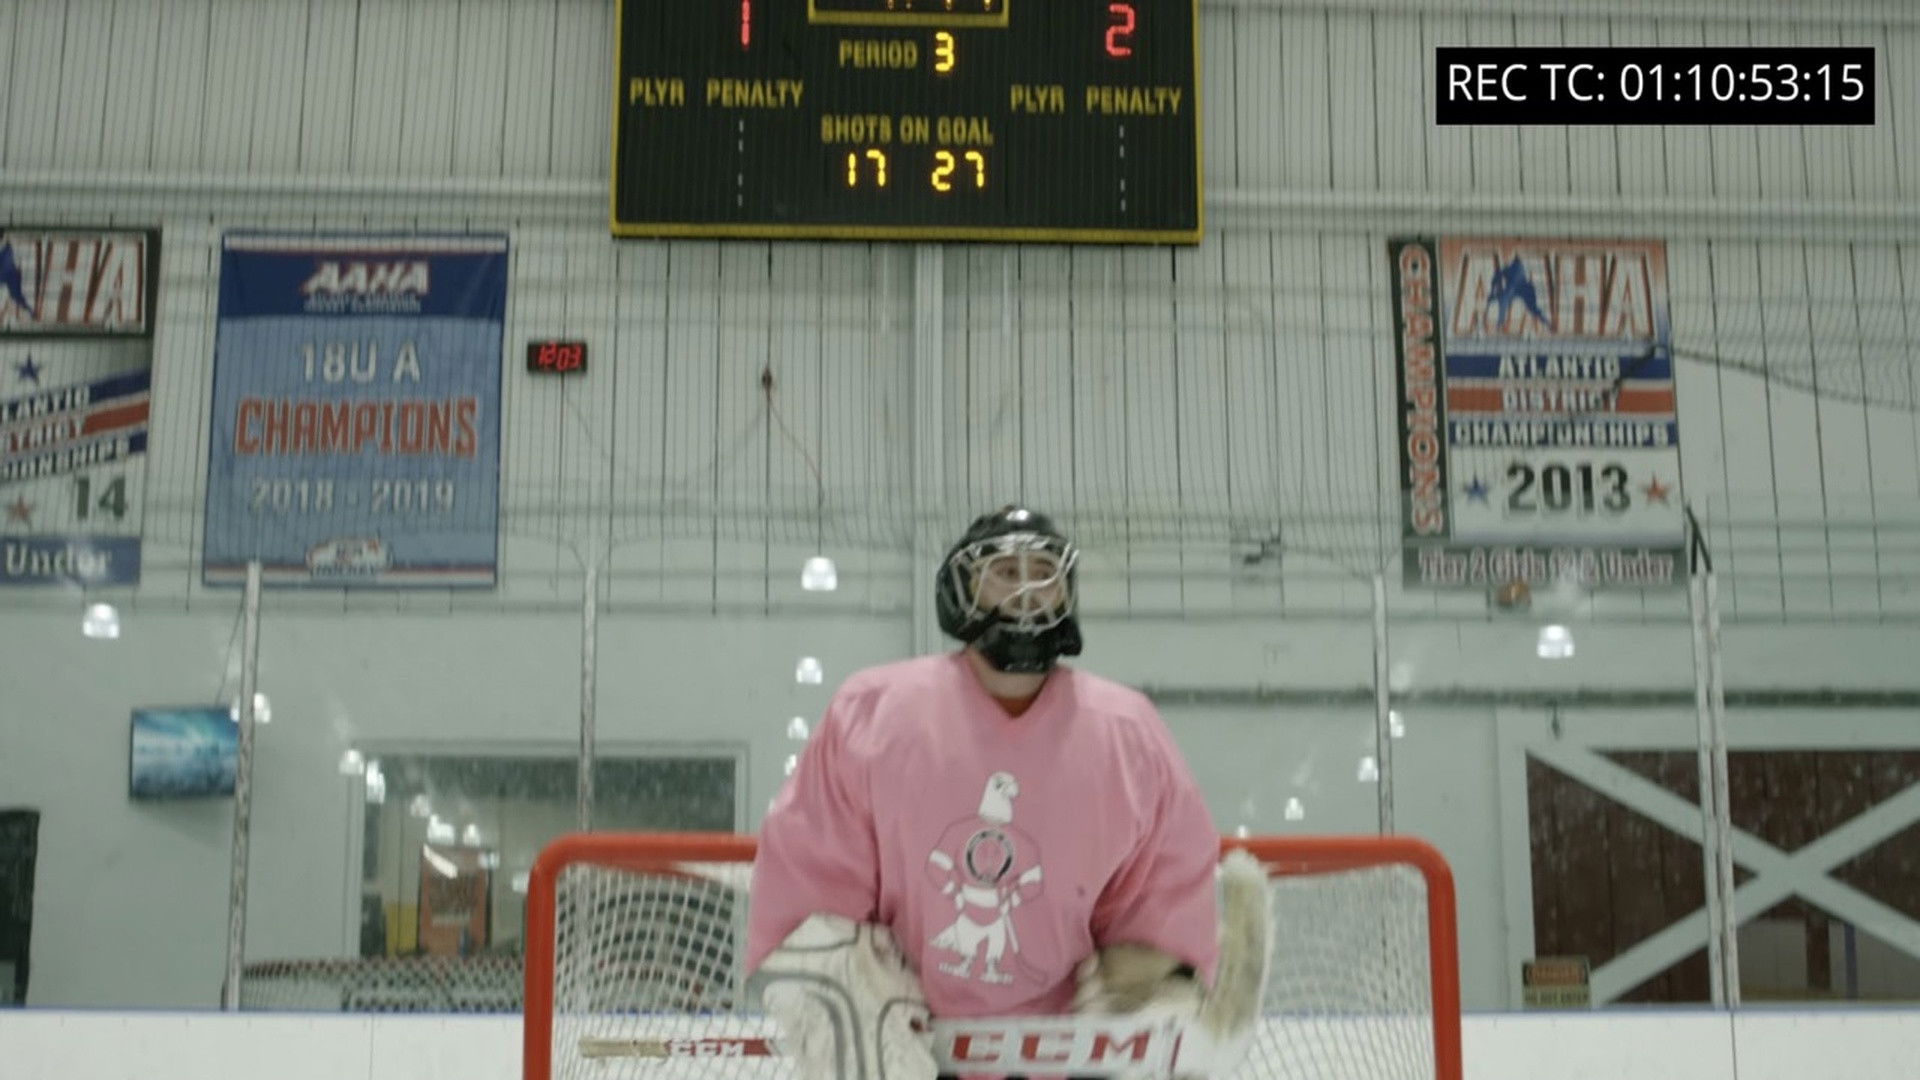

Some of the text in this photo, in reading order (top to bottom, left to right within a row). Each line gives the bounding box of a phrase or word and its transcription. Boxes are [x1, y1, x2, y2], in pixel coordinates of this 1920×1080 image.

[1105, 3, 1136, 57] 2
[839, 31, 955, 72] PERIOD 3
[629, 78, 803, 107] PLYR PENALTY
[1010, 84, 1182, 115] PLYR PENALTY
[820, 115, 994, 146] SHOTS ON GOAL
[848, 150, 984, 191] 17 27
[303, 262, 428, 294] AAHA
[303, 340, 420, 383] 18U A
[0, 384, 90, 425] LANTIC
[235, 396, 477, 460] CHAMPIONS
[1506, 463, 1632, 514] 2013
[671, 1039, 745, 1057] CCM
[952, 1031, 1150, 1062] CCM
